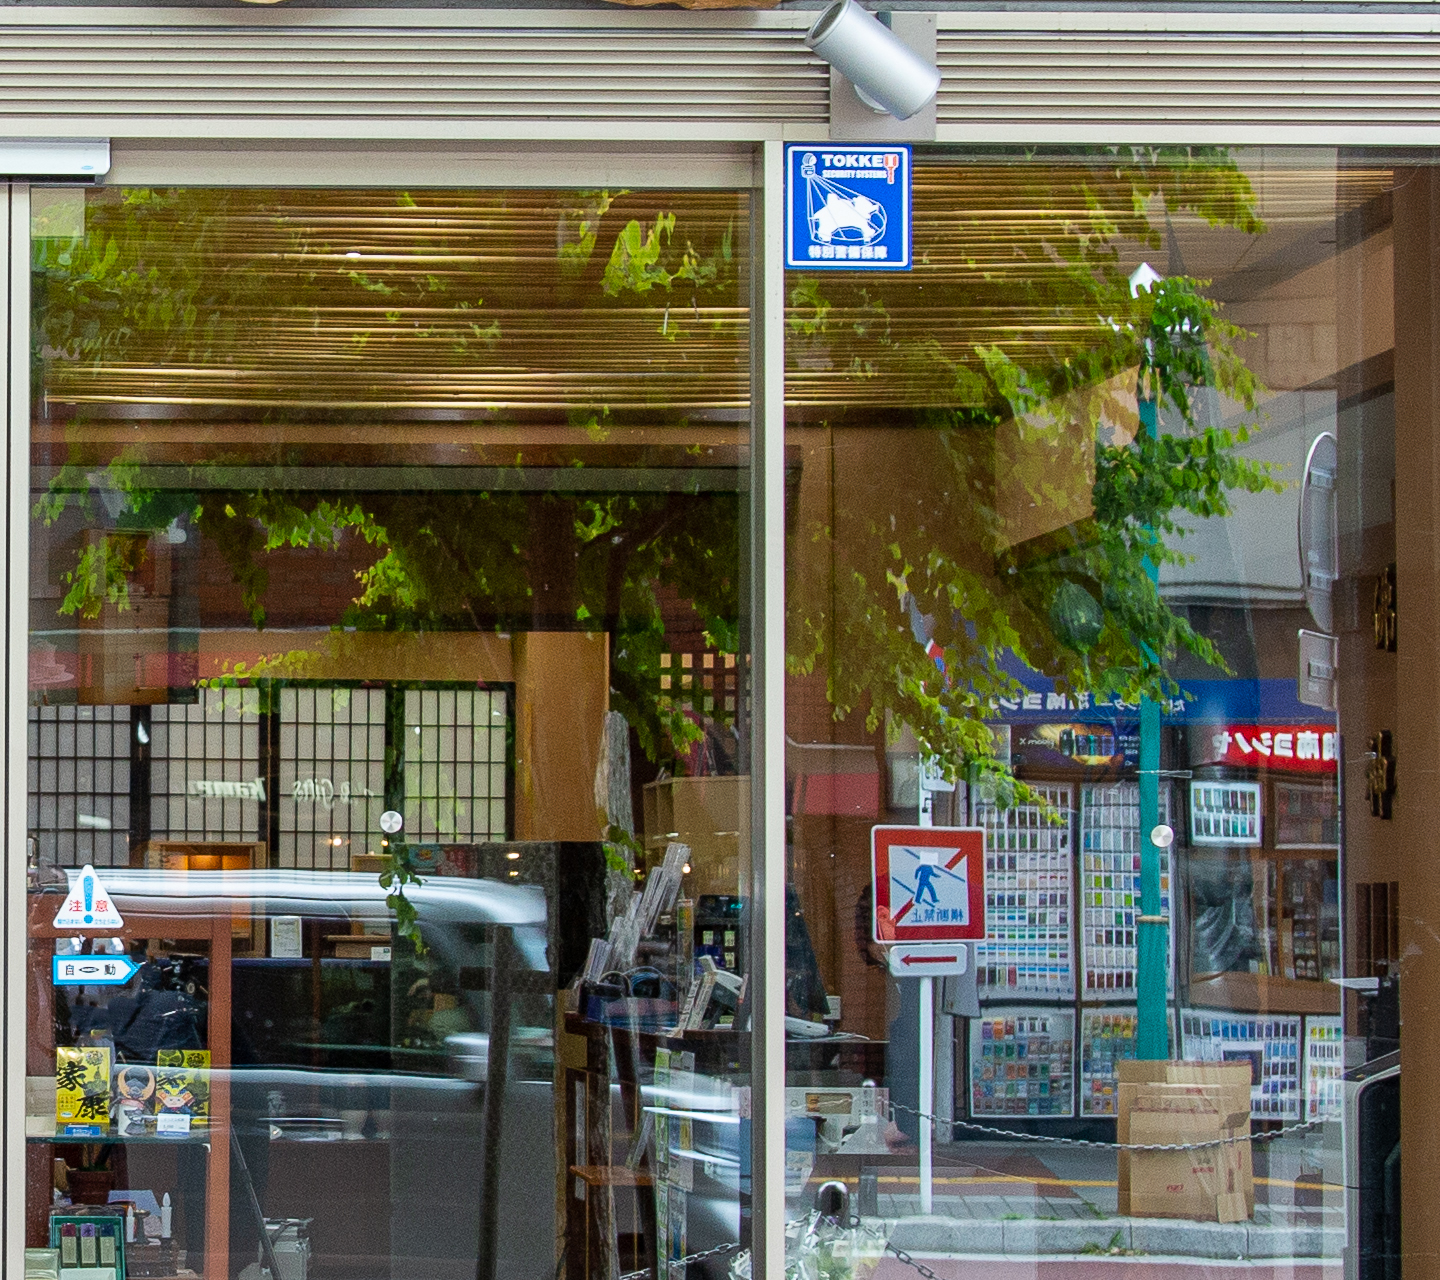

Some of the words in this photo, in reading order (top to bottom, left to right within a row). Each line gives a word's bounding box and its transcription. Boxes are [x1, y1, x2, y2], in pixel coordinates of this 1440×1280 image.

[822, 170, 856, 178] SECURITY
[857, 170, 888, 178] SYSTEMS
[808, 245, 888, 259] 特別警備保障
